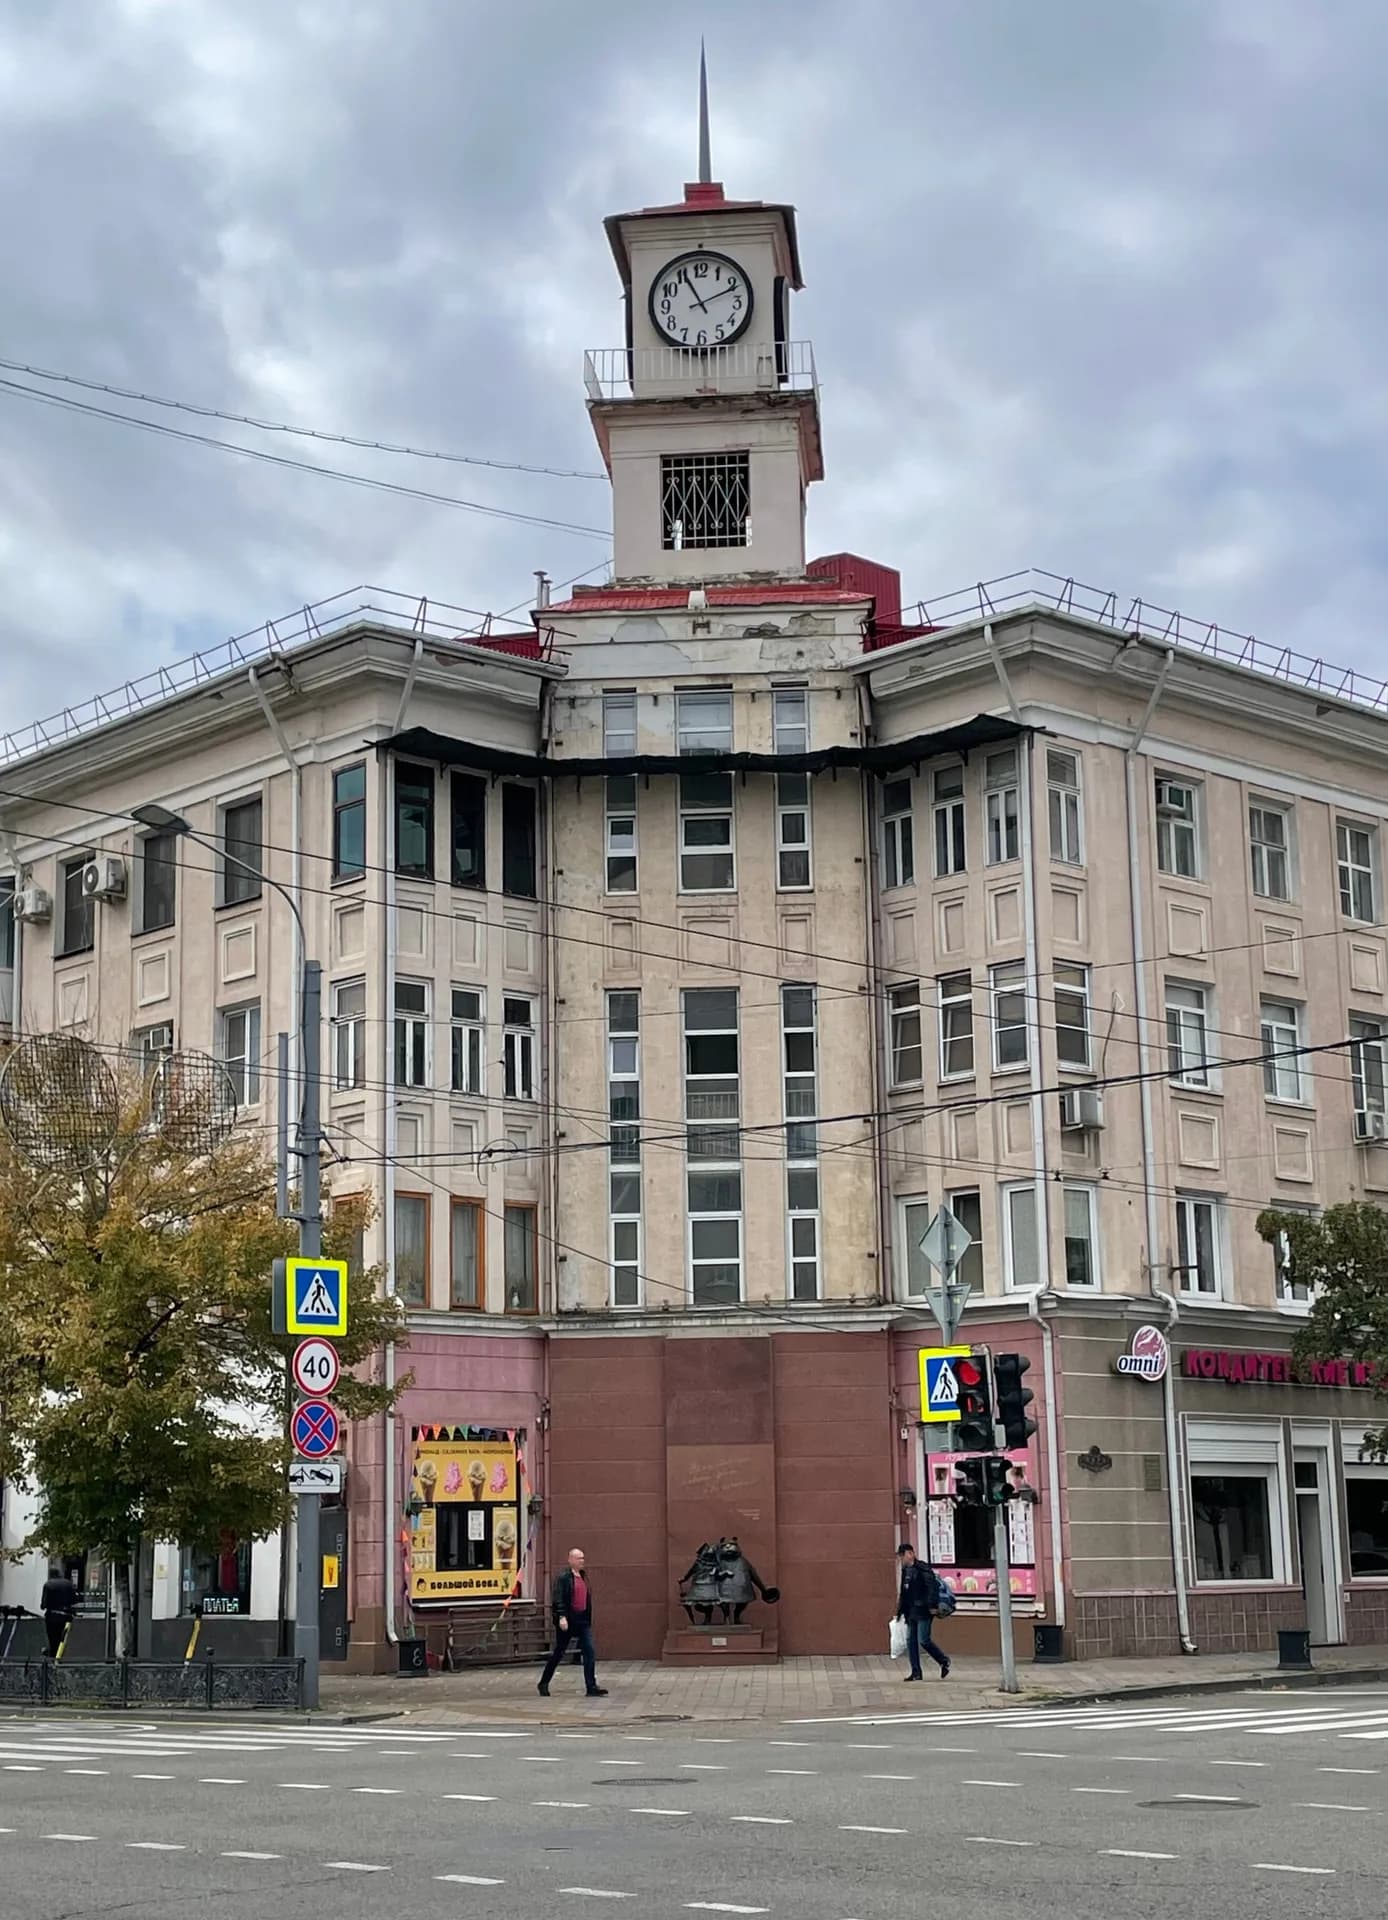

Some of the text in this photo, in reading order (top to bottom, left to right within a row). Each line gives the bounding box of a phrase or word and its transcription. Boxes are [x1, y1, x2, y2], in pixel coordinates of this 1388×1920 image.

[677, 267, 688, 284] 11
[694, 263, 708, 278] 12
[715, 266, 720, 281] 1
[663, 282, 678, 298] 10
[728, 277, 736, 291] 2
[661, 299, 671, 315] 9
[733, 295, 742, 310] 3
[667, 315, 676, 331] 8
[727, 312, 735, 326] 4
[680, 327, 688, 342] 7
[696, 330, 707, 346] 6
[715, 324, 724, 340] 5
[302, 1356, 330, 1379] 40
[1118, 1354, 1160, 1373] omni
[1186, 1349, 1348, 1387] КОНДИТЕКИЕ
[430, 1578, 474, 1590] БОЛЬШОЙ
[203, 1597, 239, 1613] ПЛАТЬЯ
